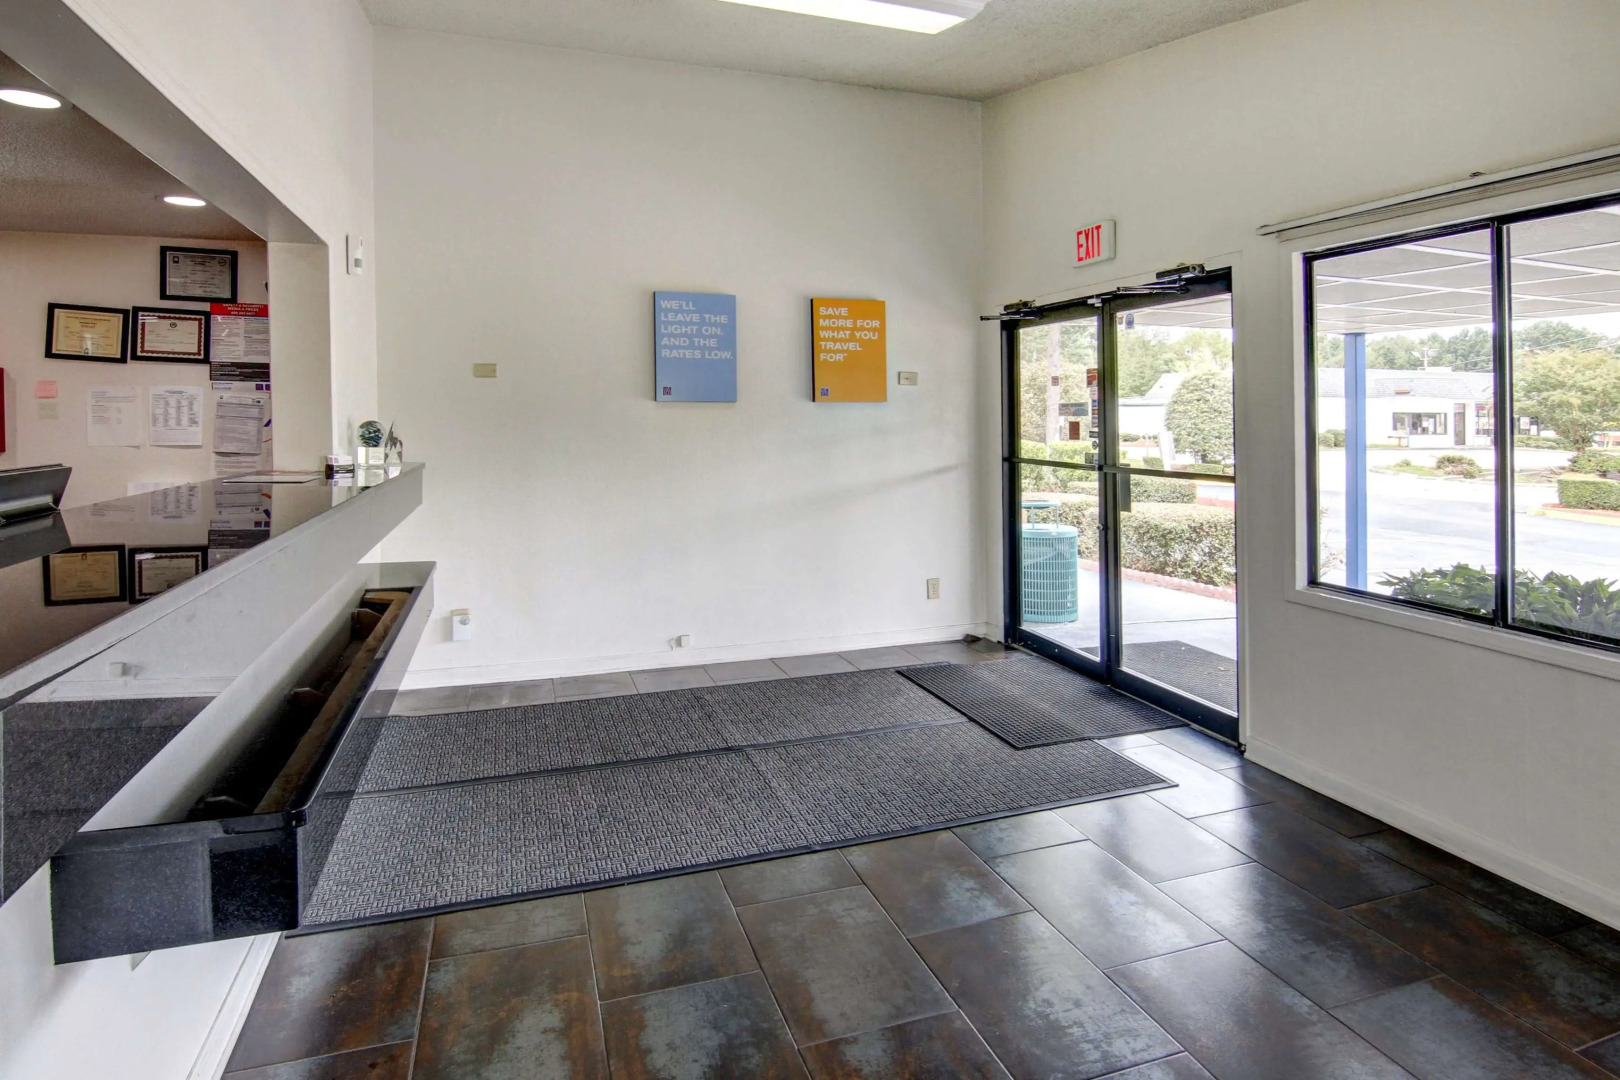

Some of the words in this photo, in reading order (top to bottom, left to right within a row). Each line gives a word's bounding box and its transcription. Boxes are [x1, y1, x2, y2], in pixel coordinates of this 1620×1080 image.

[1076, 224, 1102, 262] EXIT
[660, 300, 696, 310] WE'LL
[819, 306, 848, 316] SAVE
[660, 312, 700, 322] LEAVE
[703, 314, 729, 323] THE
[819, 318, 854, 328] MORE
[856, 319, 880, 328] FOR
[661, 325, 698, 334] LIGHT
[702, 326, 724, 336] ON.
[819, 330, 851, 339] WHAT
[854, 331, 878, 340] YOU
[661, 337, 689, 346] AND
[692, 338, 718, 347] THE
[819, 341, 863, 351] TRAVEL
[661, 349, 702, 359] RATES
[705, 350, 733, 359] LOW.
